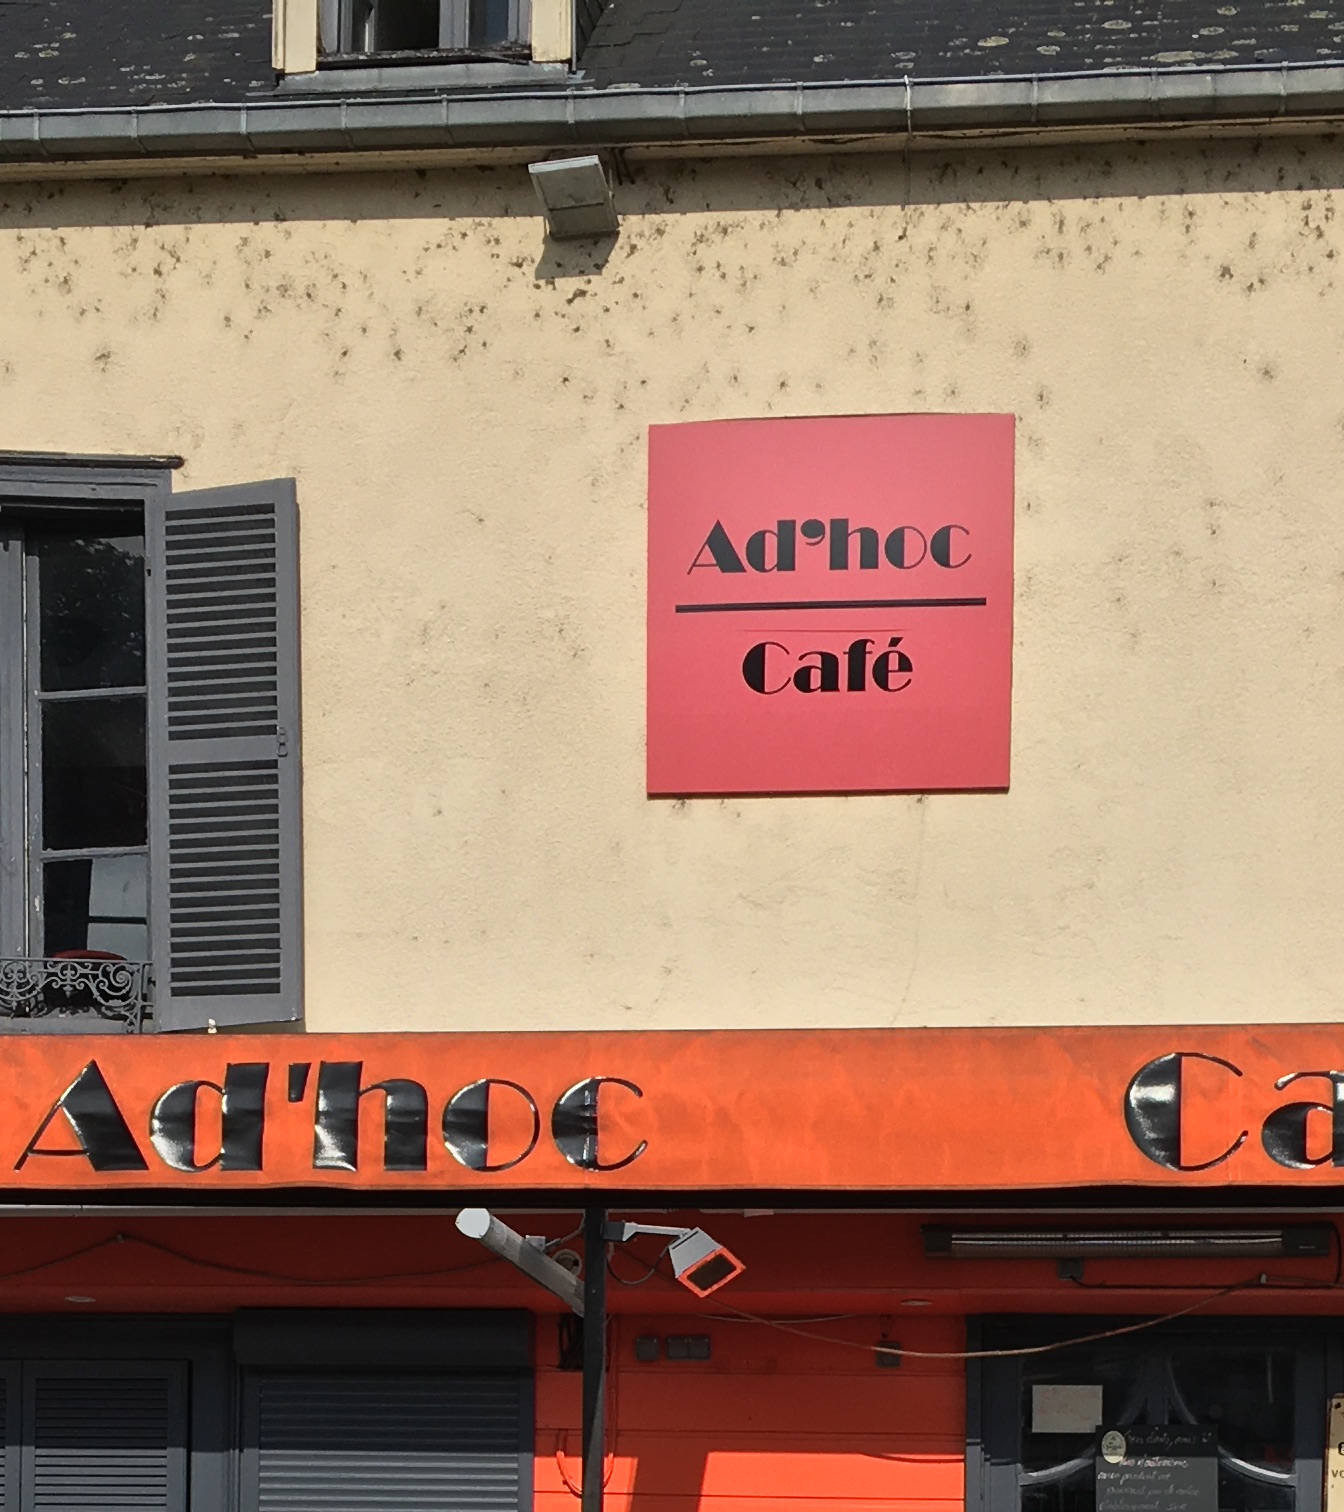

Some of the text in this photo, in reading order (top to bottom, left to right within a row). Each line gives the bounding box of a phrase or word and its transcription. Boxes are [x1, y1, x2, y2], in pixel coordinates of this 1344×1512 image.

[687, 517, 973, 576] Ad'hoc
[742, 636, 914, 695] Café
[12, 1059, 649, 1173] Ad'hoc
